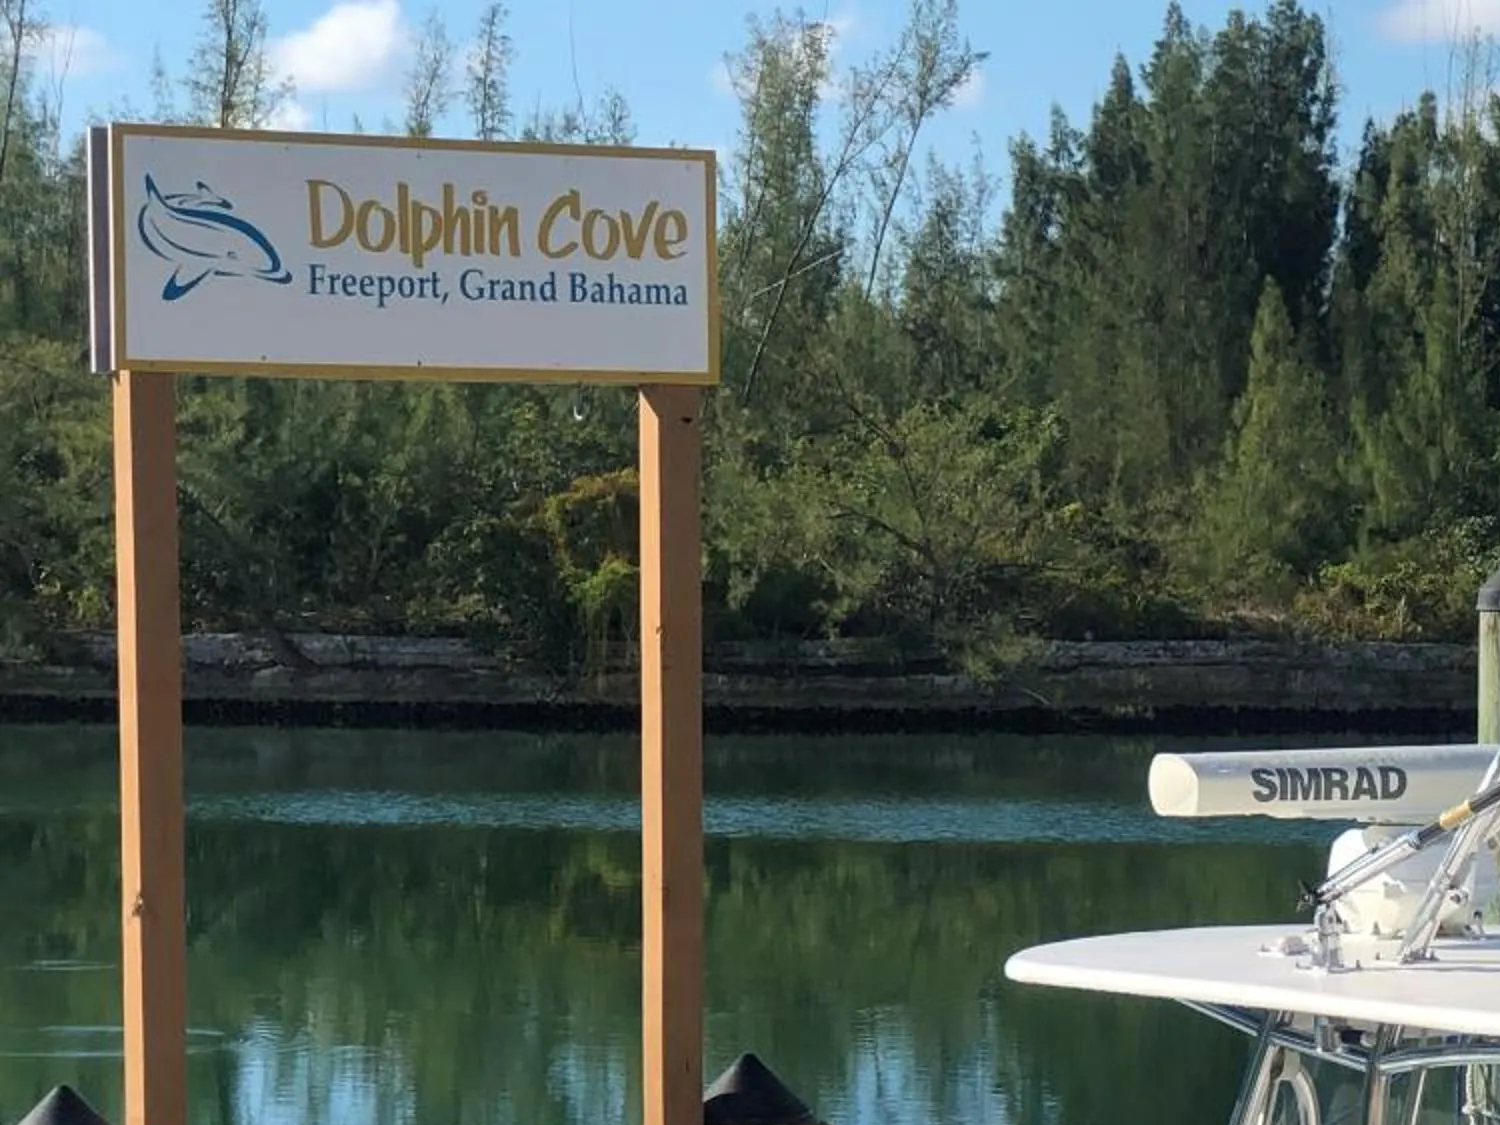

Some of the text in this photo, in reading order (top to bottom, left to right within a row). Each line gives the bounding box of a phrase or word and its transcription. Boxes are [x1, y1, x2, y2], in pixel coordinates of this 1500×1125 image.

[306, 179, 688, 268] Dolphin Cove
[308, 263, 689, 308] Freeport, Grand Bahama
[1251, 766, 1408, 802] SIMRAD
